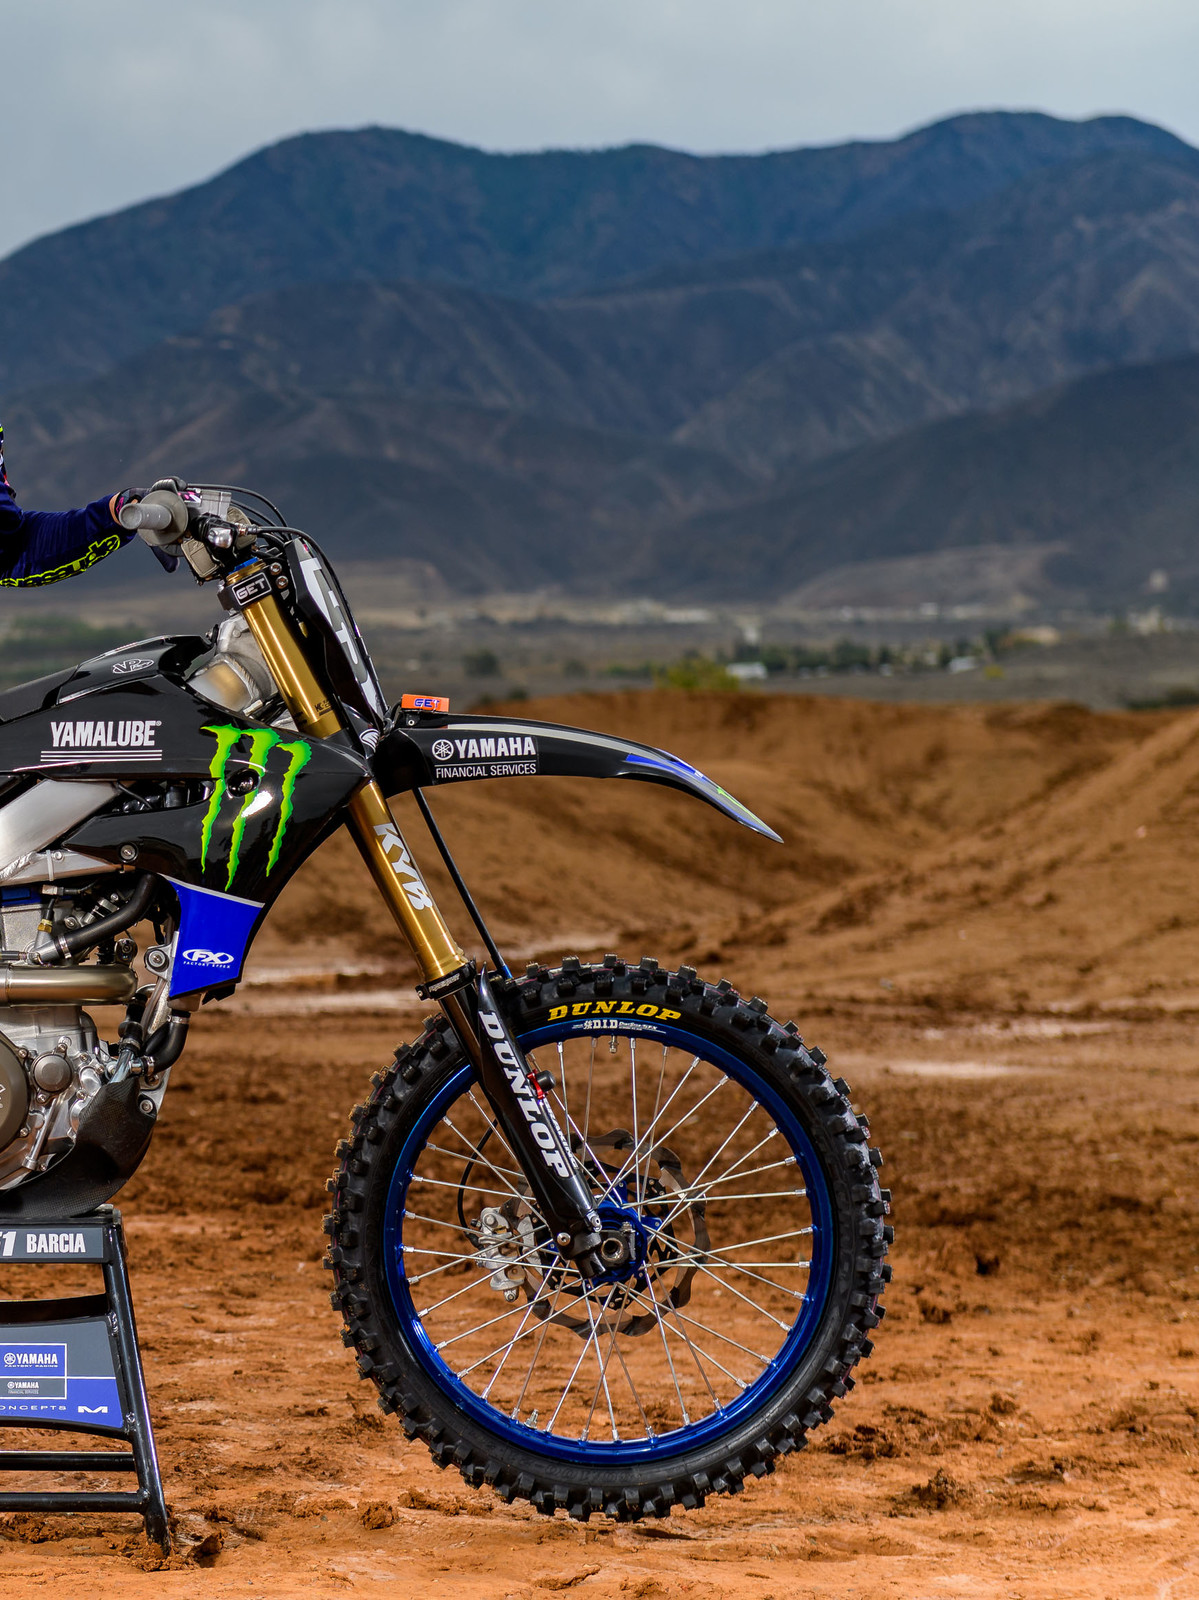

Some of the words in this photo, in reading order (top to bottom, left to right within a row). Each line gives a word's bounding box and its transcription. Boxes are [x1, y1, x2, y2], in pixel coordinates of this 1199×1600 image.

[236, 577, 266, 600] GET
[414, 698, 440, 708] GET
[50, 720, 157, 747] YAMALUBE
[454, 736, 537, 759] YAMAHA
[436, 765, 488, 779] FINANCIAL
[490, 763, 537, 776] SERVICES
[373, 822, 433, 911] KYB
[547, 1000, 682, 1021] DUNLOP
[478, 1010, 570, 1178] DUNLOP
[26, 1233, 86, 1253] BARCIA
[16, 1353, 58, 1364] YAMAHA
[14, 1381, 40, 1389] YAMAHA
